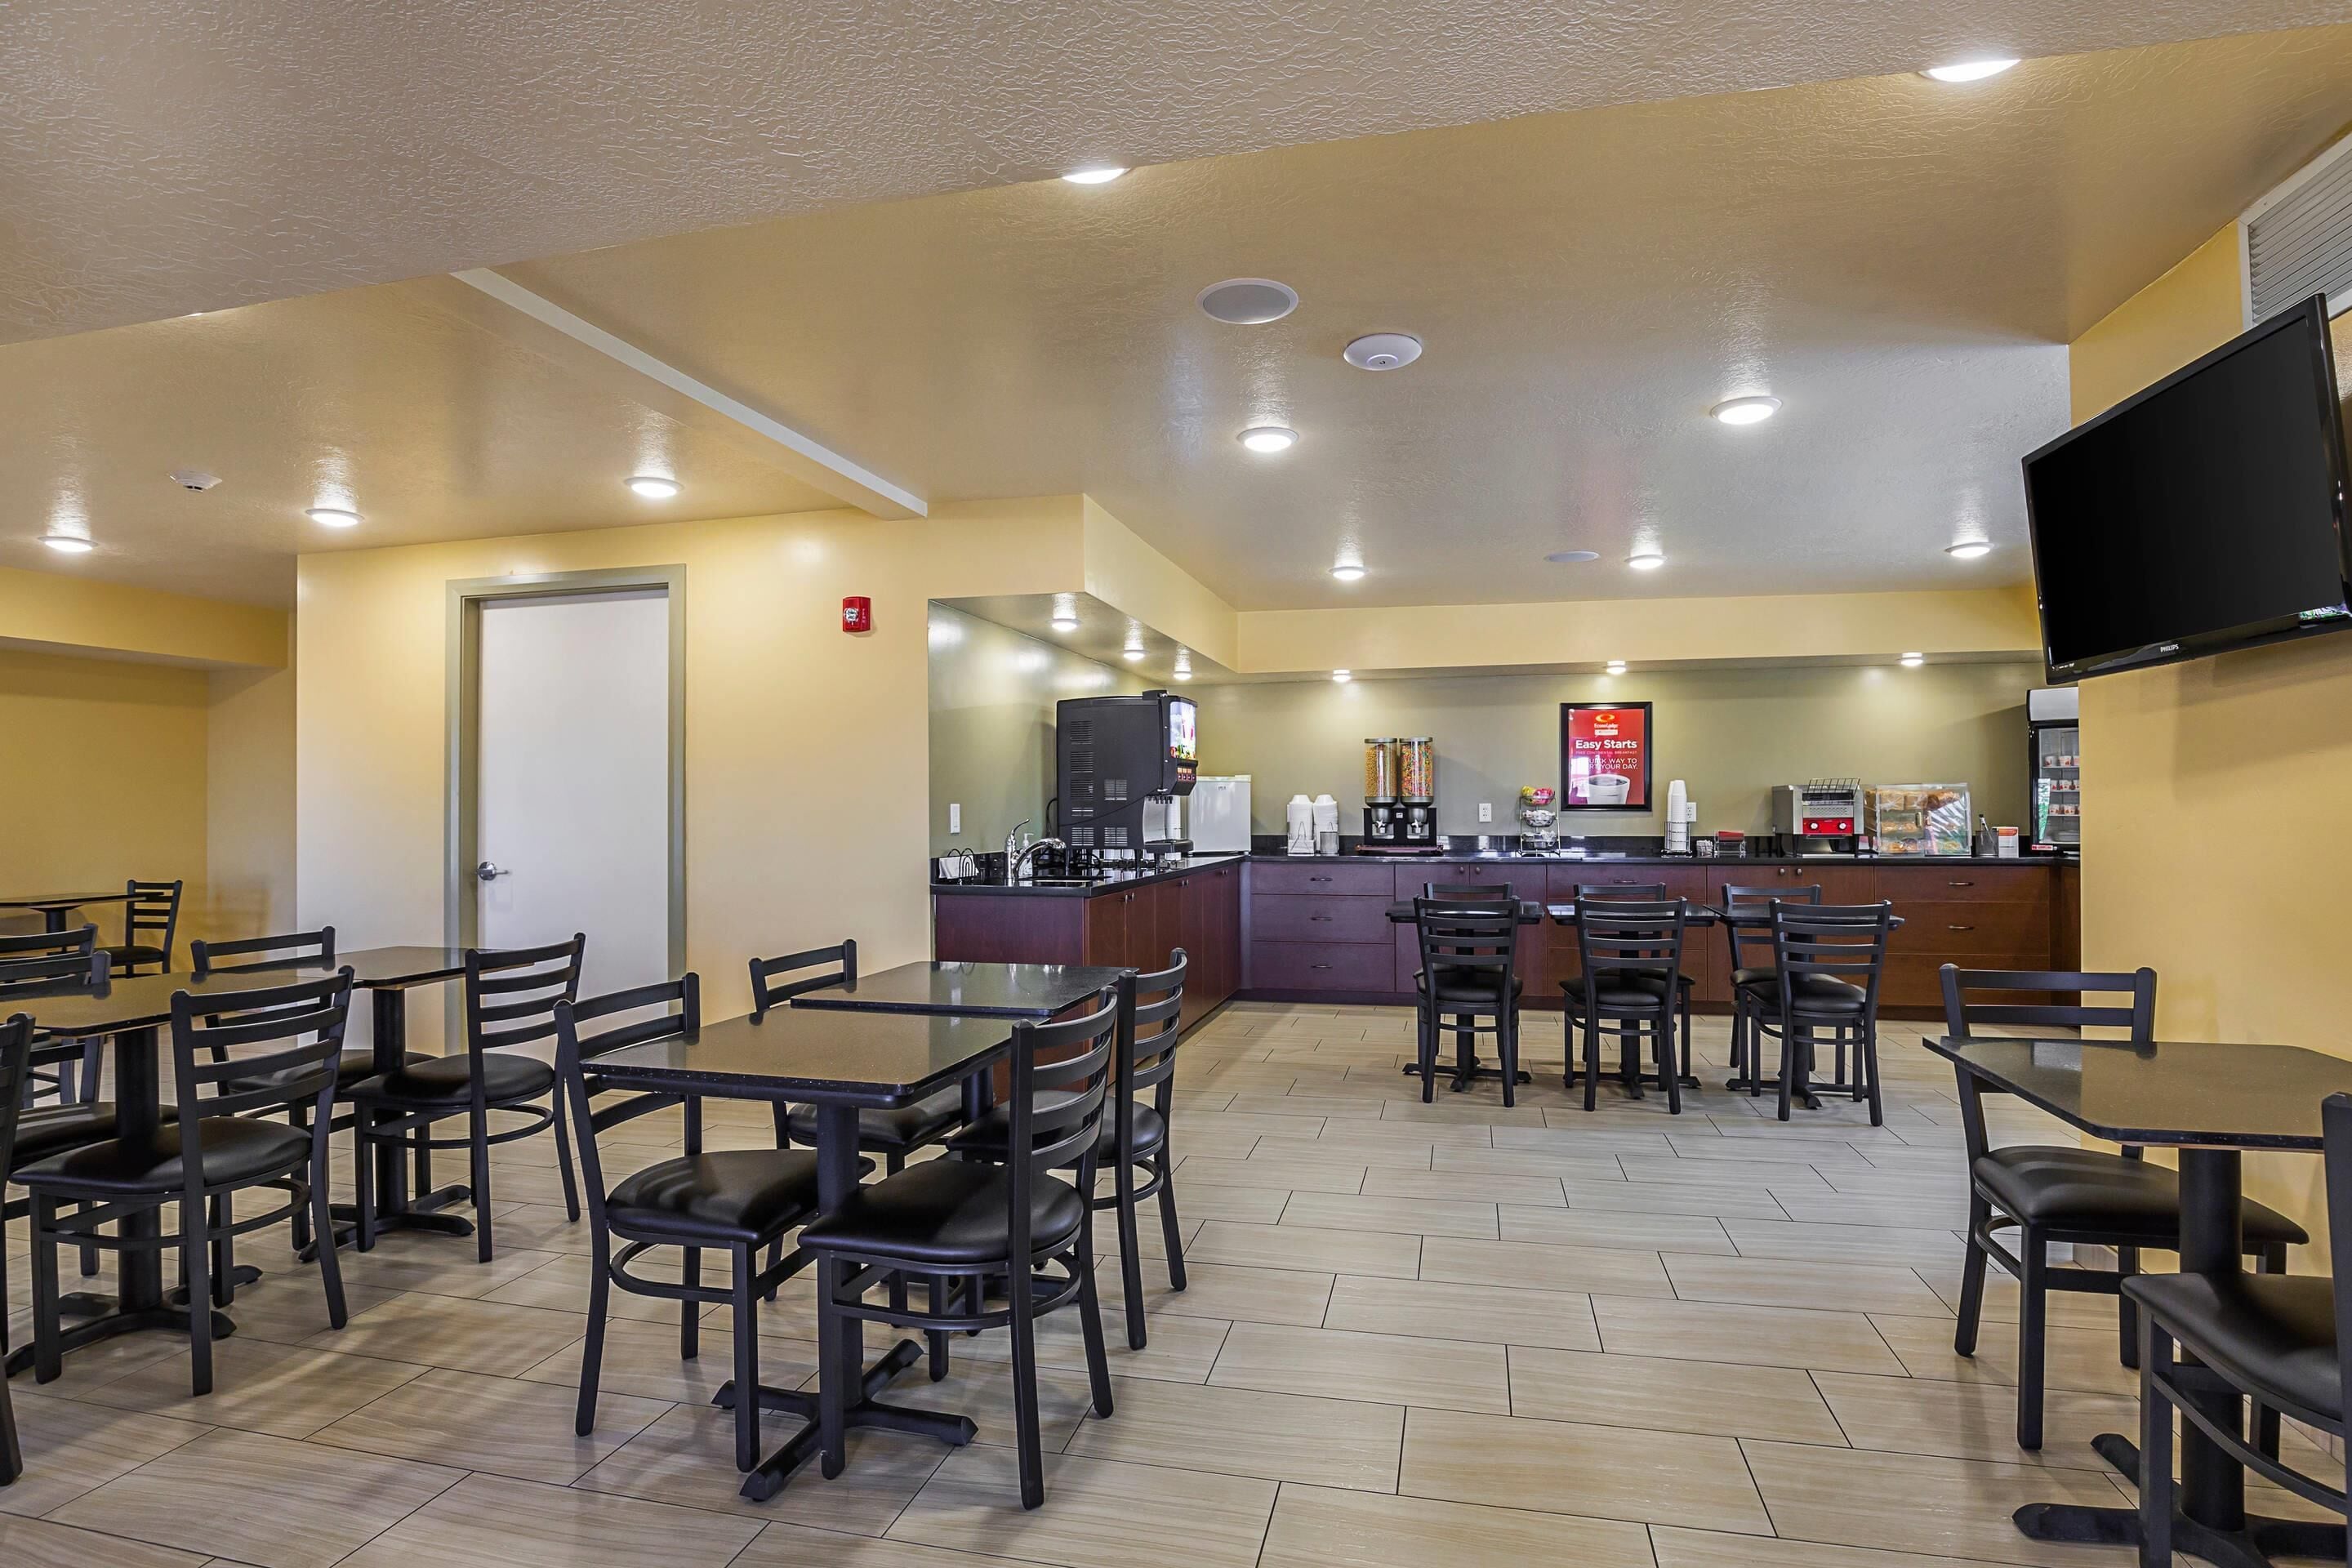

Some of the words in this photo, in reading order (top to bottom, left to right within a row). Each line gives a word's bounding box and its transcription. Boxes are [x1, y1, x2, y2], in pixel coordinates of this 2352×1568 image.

[2160, 644, 2179, 653] PHILIPS
[1575, 739, 1601, 751] Easy
[1603, 739, 1637, 749] Starts
